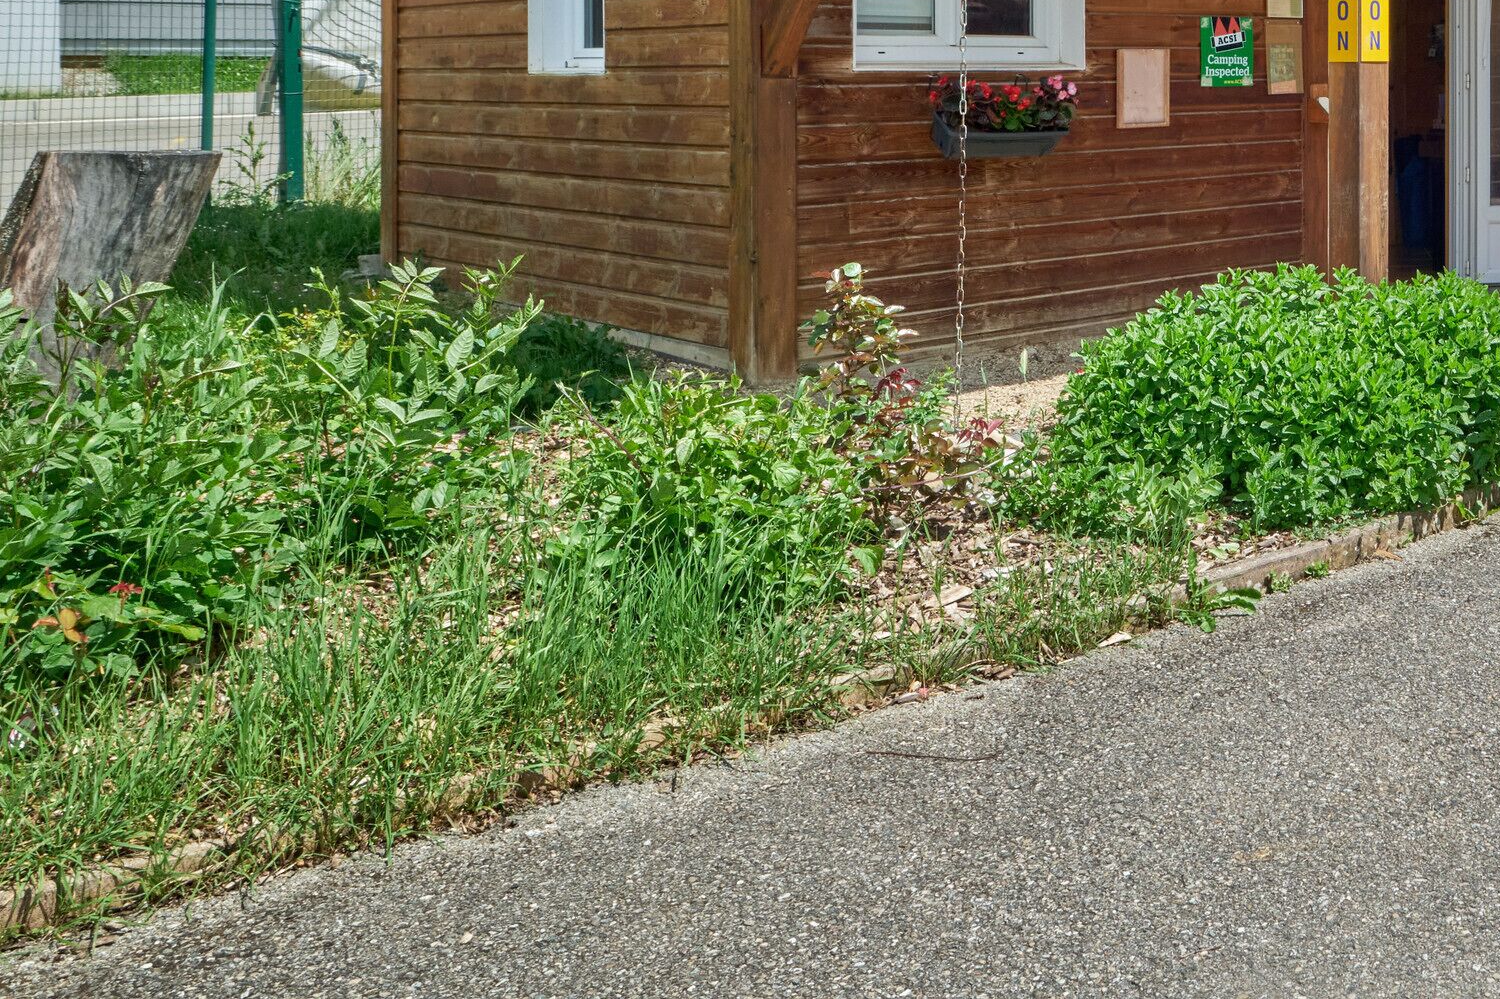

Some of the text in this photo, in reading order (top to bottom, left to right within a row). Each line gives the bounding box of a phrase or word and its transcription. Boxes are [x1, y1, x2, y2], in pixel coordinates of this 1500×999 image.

[1217, 34, 1238, 45] ACSI
[1207, 54, 1249, 67] Camping
[1205, 66, 1250, 78] Inspected
